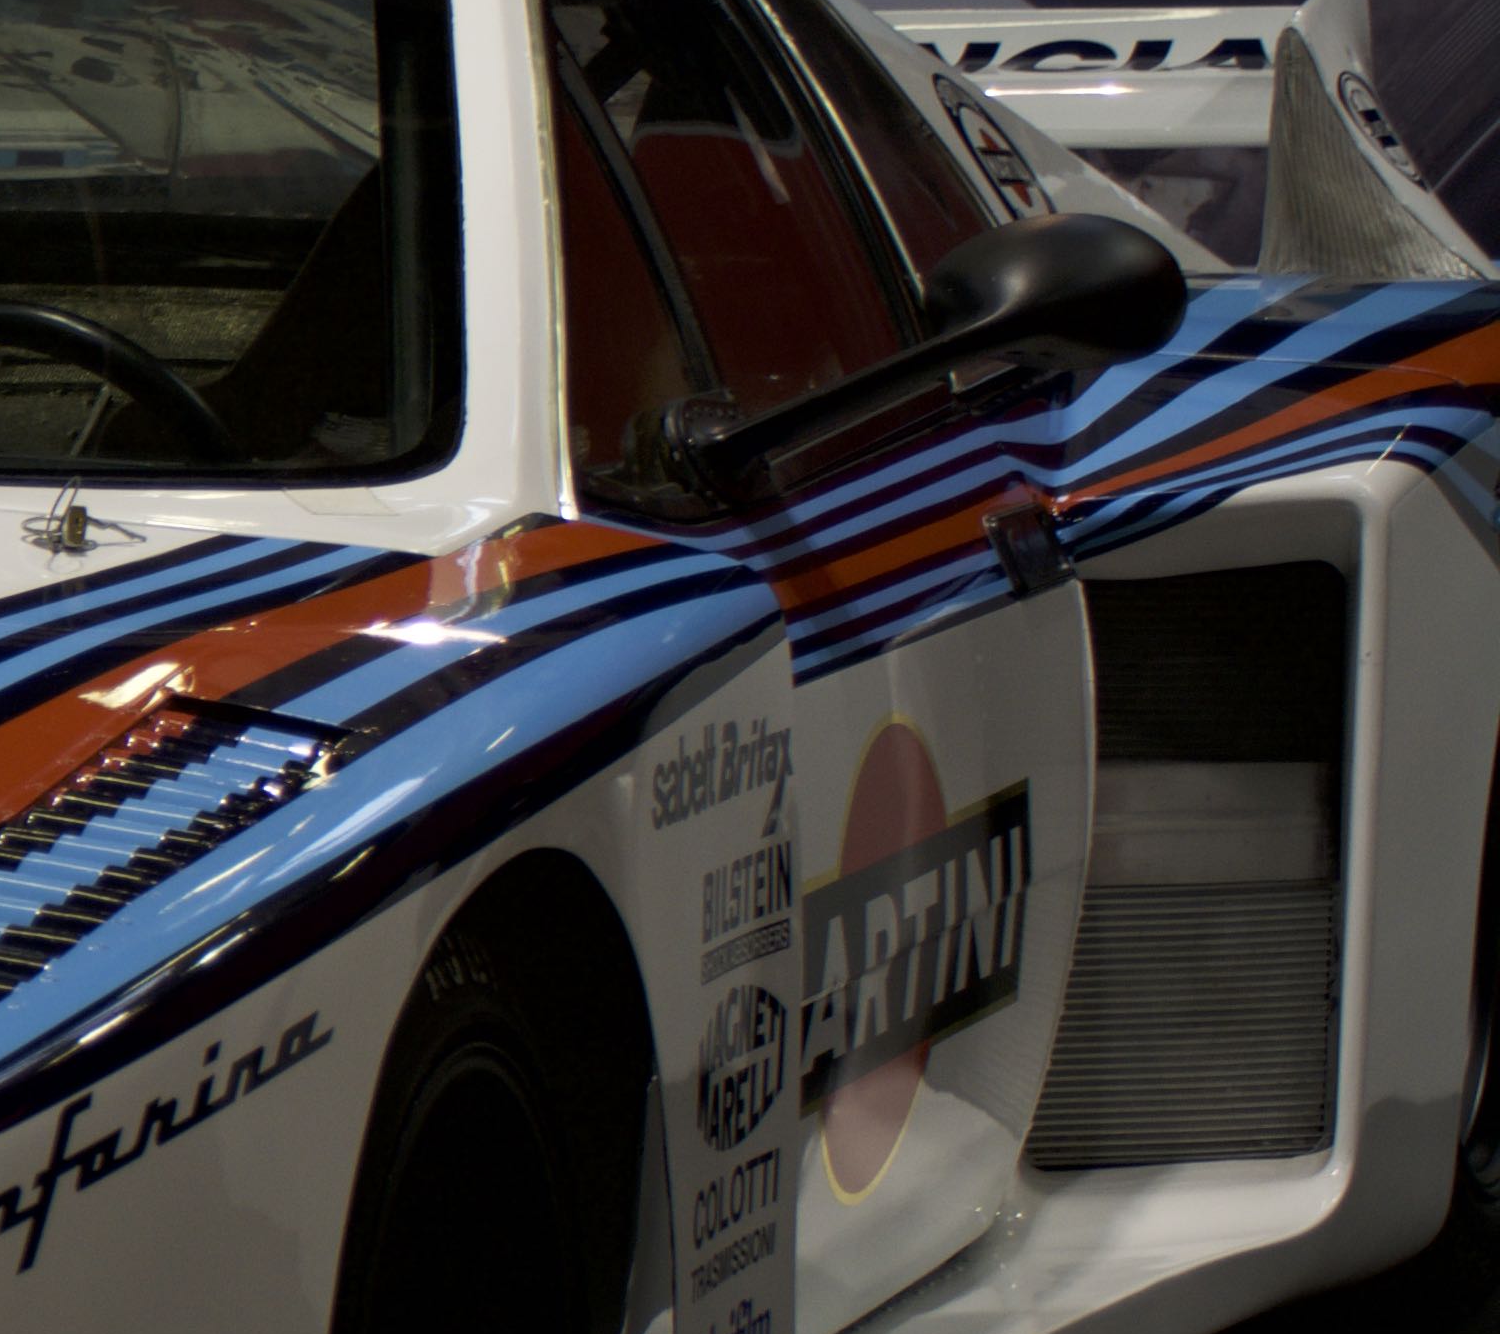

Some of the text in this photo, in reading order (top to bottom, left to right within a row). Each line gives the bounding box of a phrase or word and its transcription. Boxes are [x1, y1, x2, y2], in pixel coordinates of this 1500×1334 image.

[916, 37, 1269, 73] NCIA
[651, 716, 793, 837] sabelt Britax
[702, 840, 791, 945] BILSTEIN
[801, 823, 1023, 1079] ARTINI
[693, 1147, 781, 1249] COLOTTI
[690, 1221, 777, 1305] TRASMISSIONI
